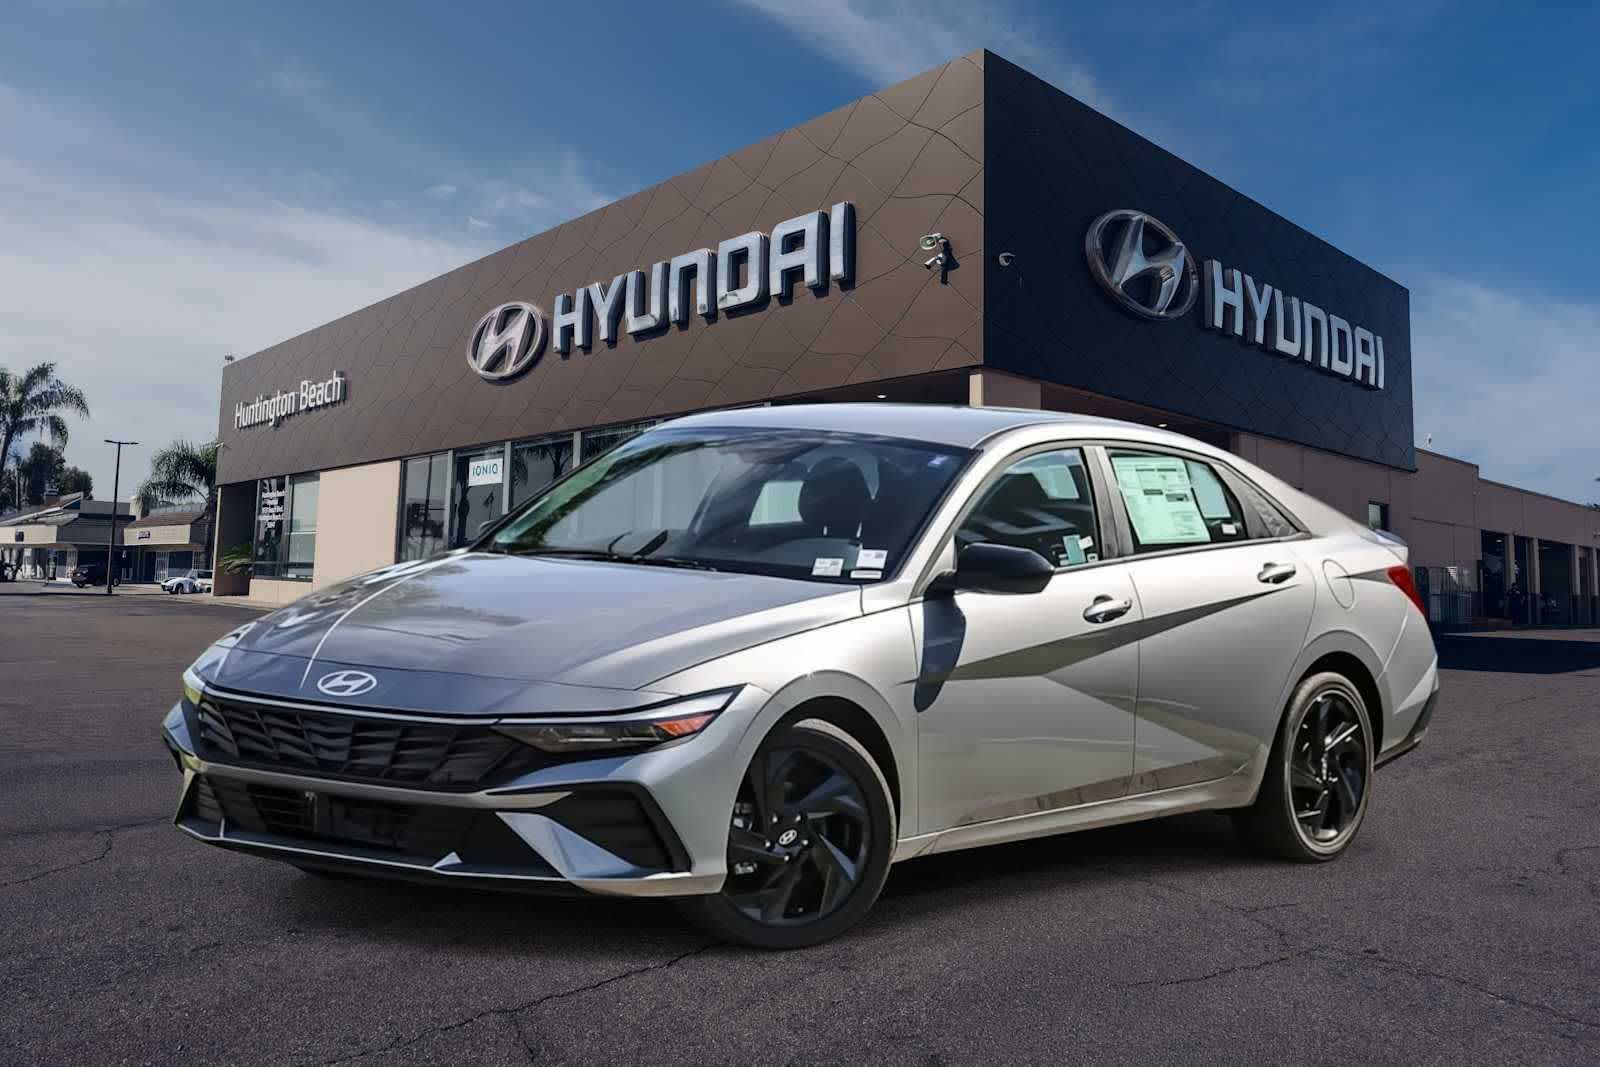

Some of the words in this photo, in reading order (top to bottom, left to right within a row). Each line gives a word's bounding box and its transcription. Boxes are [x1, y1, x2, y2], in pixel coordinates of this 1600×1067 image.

[553, 201, 853, 353] HYUNDAI
[1207, 258, 1385, 390] HYUNDAI
[234, 390, 297, 428] Huntington
[299, 370, 345, 411] Beach
